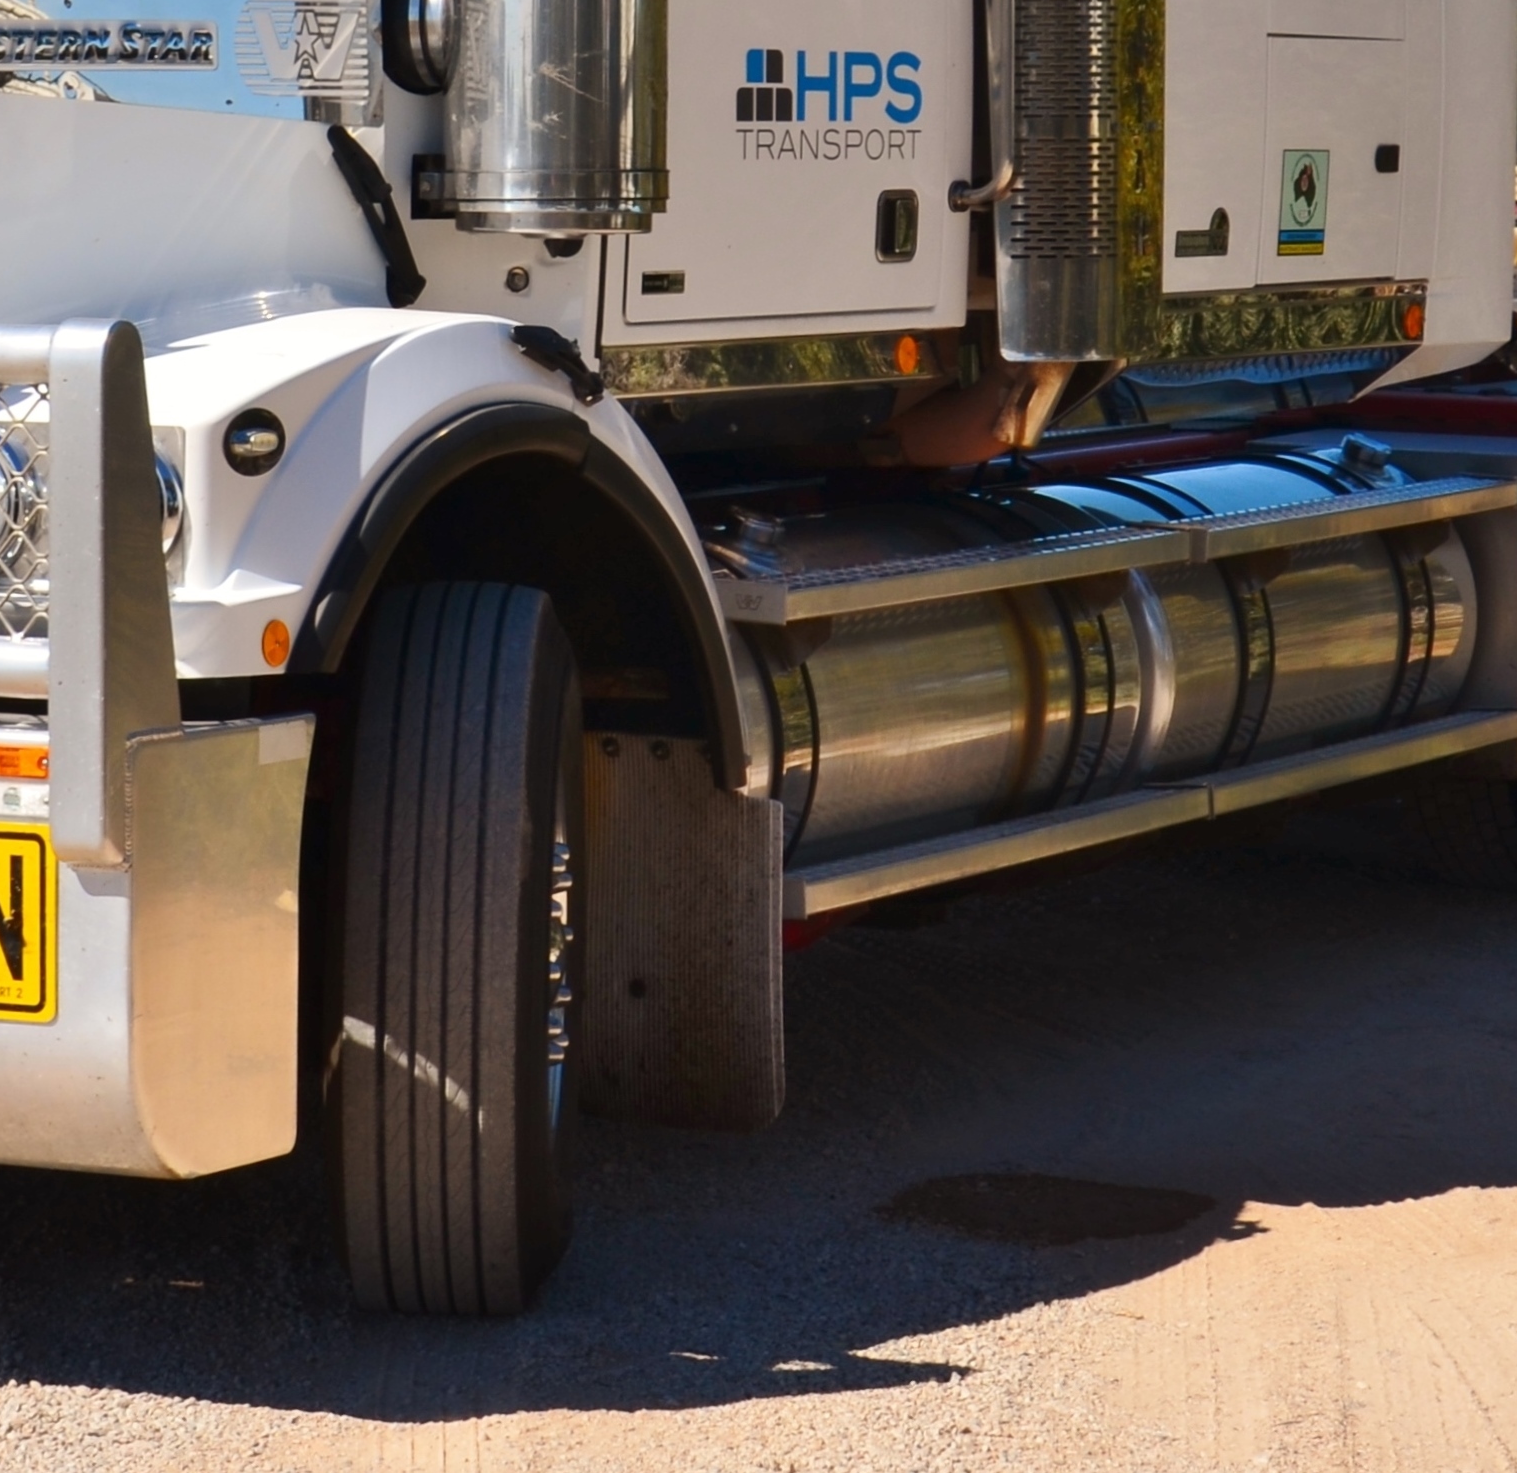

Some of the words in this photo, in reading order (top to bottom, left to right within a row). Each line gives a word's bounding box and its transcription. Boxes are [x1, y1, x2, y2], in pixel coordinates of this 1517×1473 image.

[119, 22, 214, 62] STAR
[796, 50, 923, 124] HPS
[735, 128, 923, 161] TRANSPORT
[16, 987, 23, 999] 2
